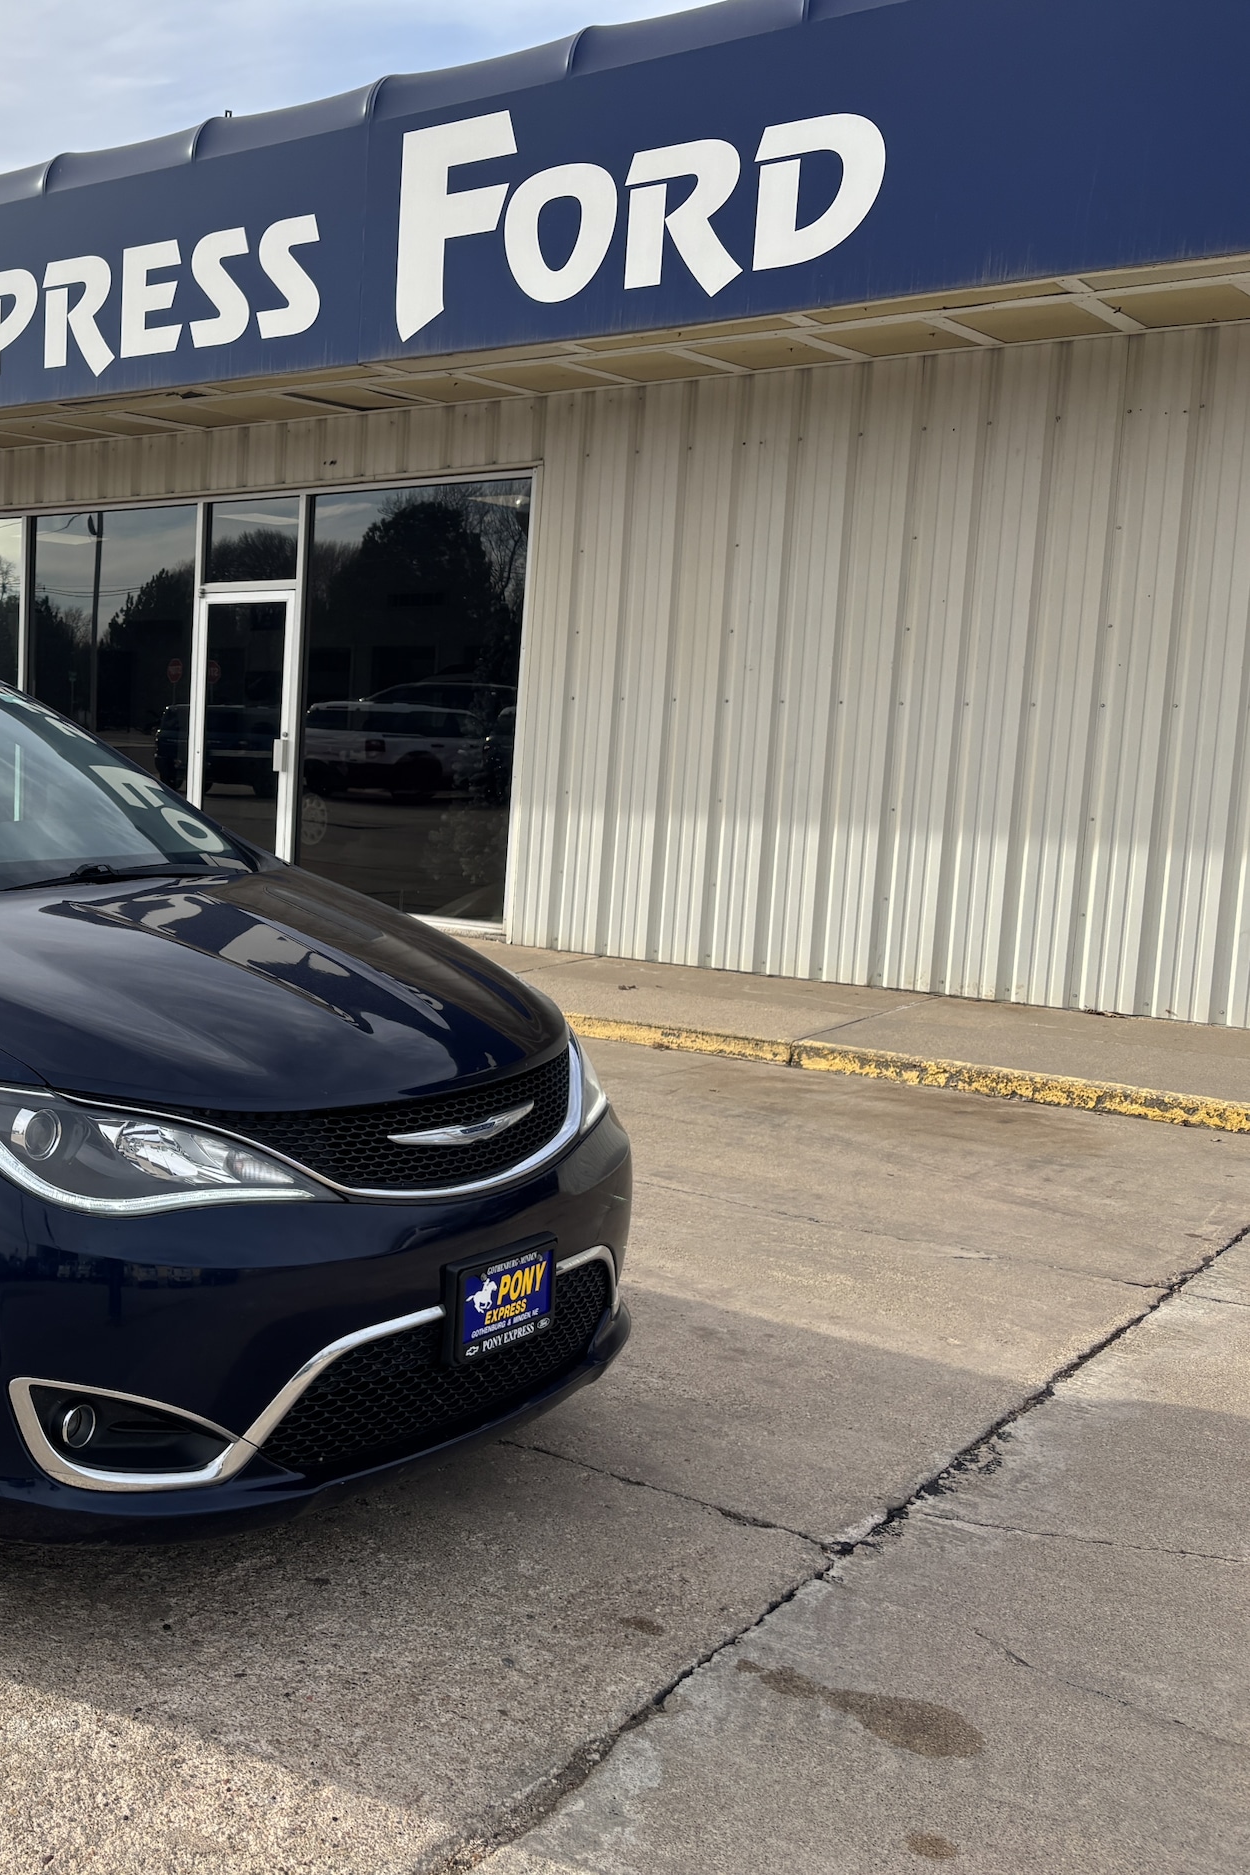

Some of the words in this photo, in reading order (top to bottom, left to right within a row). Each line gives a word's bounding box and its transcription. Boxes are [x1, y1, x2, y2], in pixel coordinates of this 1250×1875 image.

[395, 109, 886, 342] FORD
[497, 1261, 547, 1305] PONY
[484, 1298, 527, 1325] EXPRESS
[471, 1320, 507, 1339] GOTHENBURG
[482, 1333, 504, 1352] PONY
[503, 1322, 535, 1344] EXPRESS
